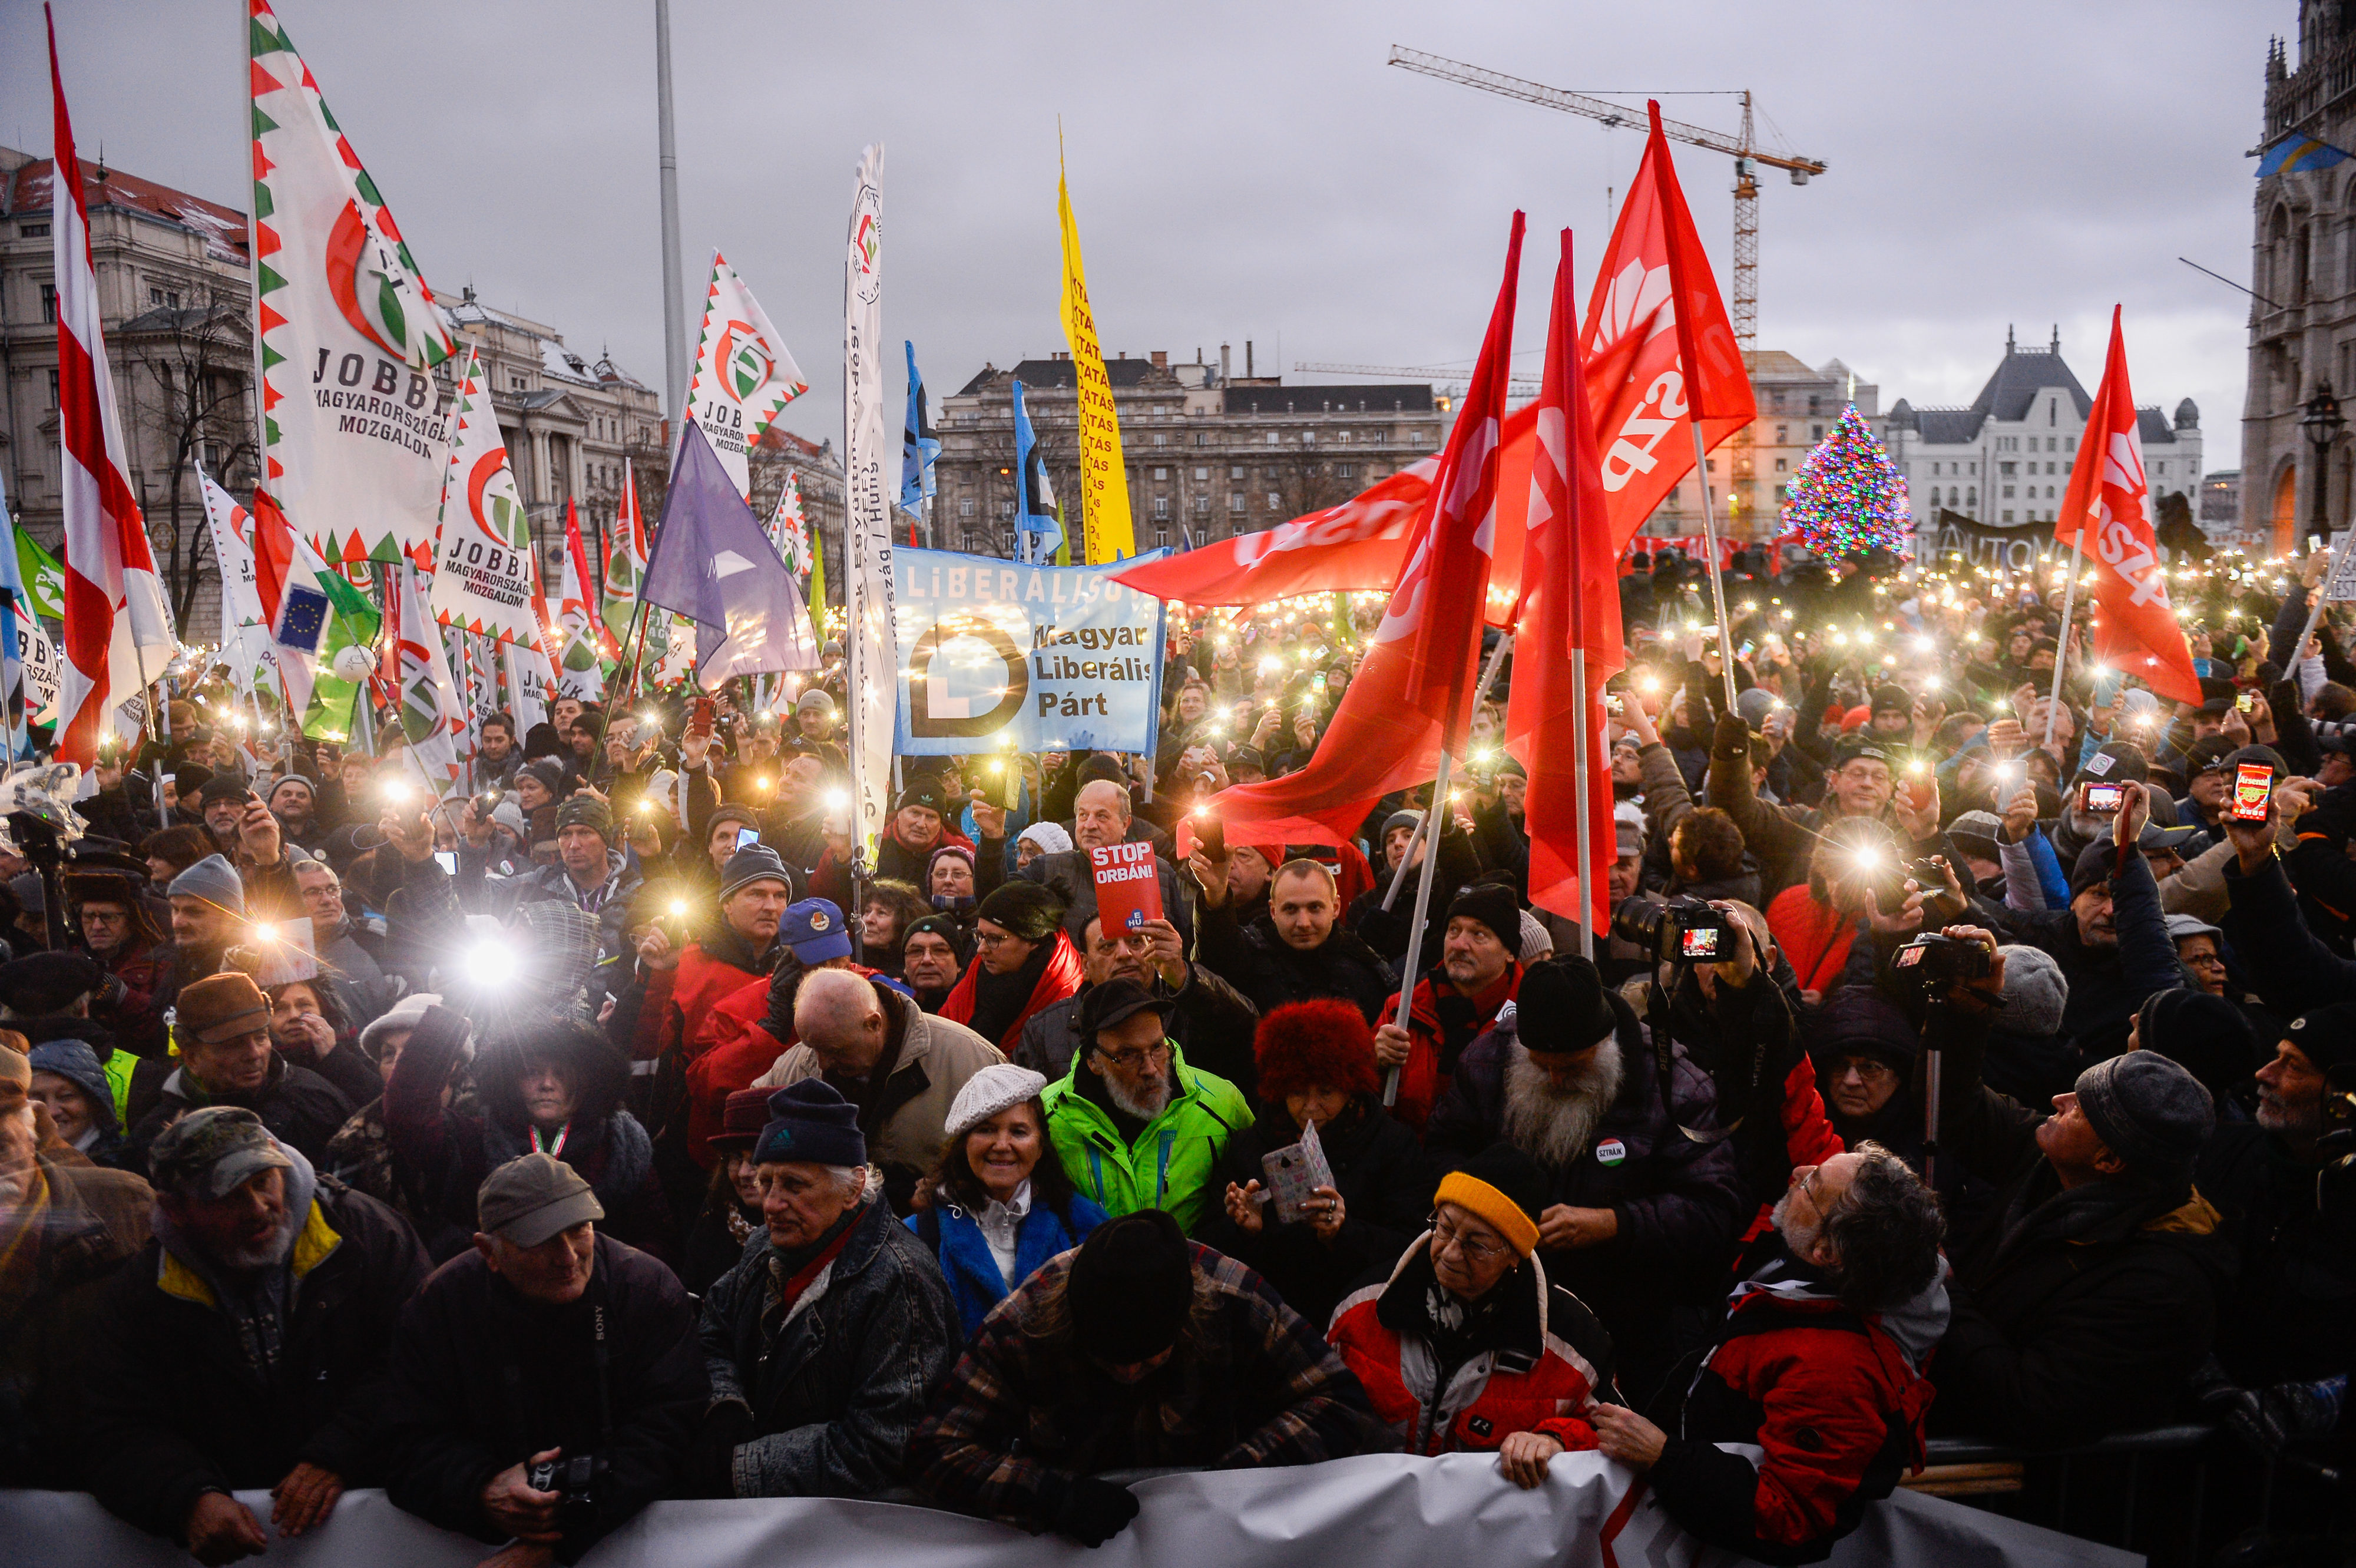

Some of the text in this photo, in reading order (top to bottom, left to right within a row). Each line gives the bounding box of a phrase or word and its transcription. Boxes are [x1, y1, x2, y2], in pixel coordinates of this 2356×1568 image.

[463, 581, 524, 608] MOZGALOM
[1033, 625, 1147, 650] Magyar
[1038, 691, 1108, 718] Párt
[2239, 776, 2268, 786] Arsenal
[1093, 842, 1151, 866] STOP
[1096, 862, 1153, 884] ORBÁN!
[1129, 918, 1141, 927] HU
[1599, 1147, 1623, 1157] SZTRÁJK
[595, 1305, 605, 1340] SONY
